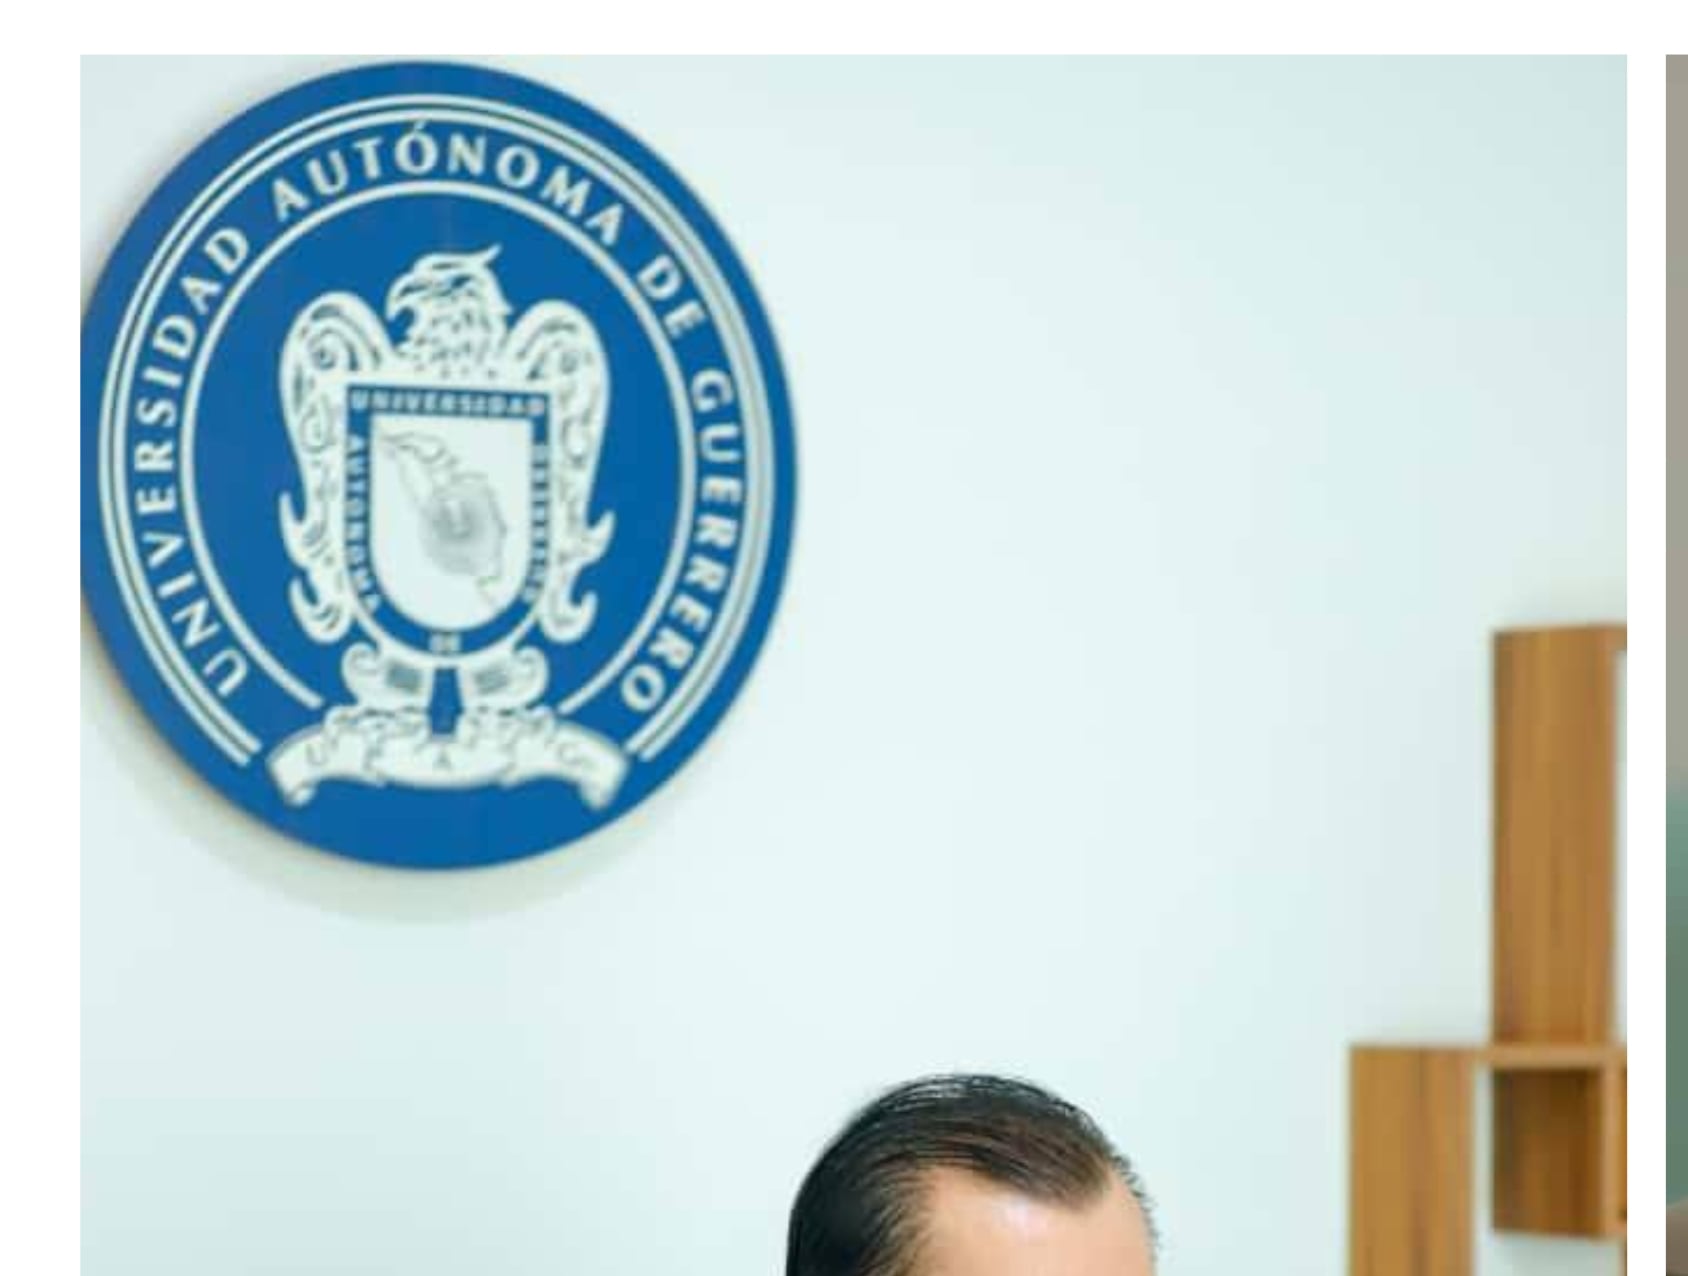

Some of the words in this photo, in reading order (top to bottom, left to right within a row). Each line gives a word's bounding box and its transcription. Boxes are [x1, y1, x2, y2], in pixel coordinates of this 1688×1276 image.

[272, 122, 622, 246] AUTÓNOMA
[637, 252, 706, 341] DE
[129, 227, 248, 703] UNIVERSIDAD
[349, 389, 547, 418] UNIVERSIDAD
[619, 368, 747, 712] GUERRERO
